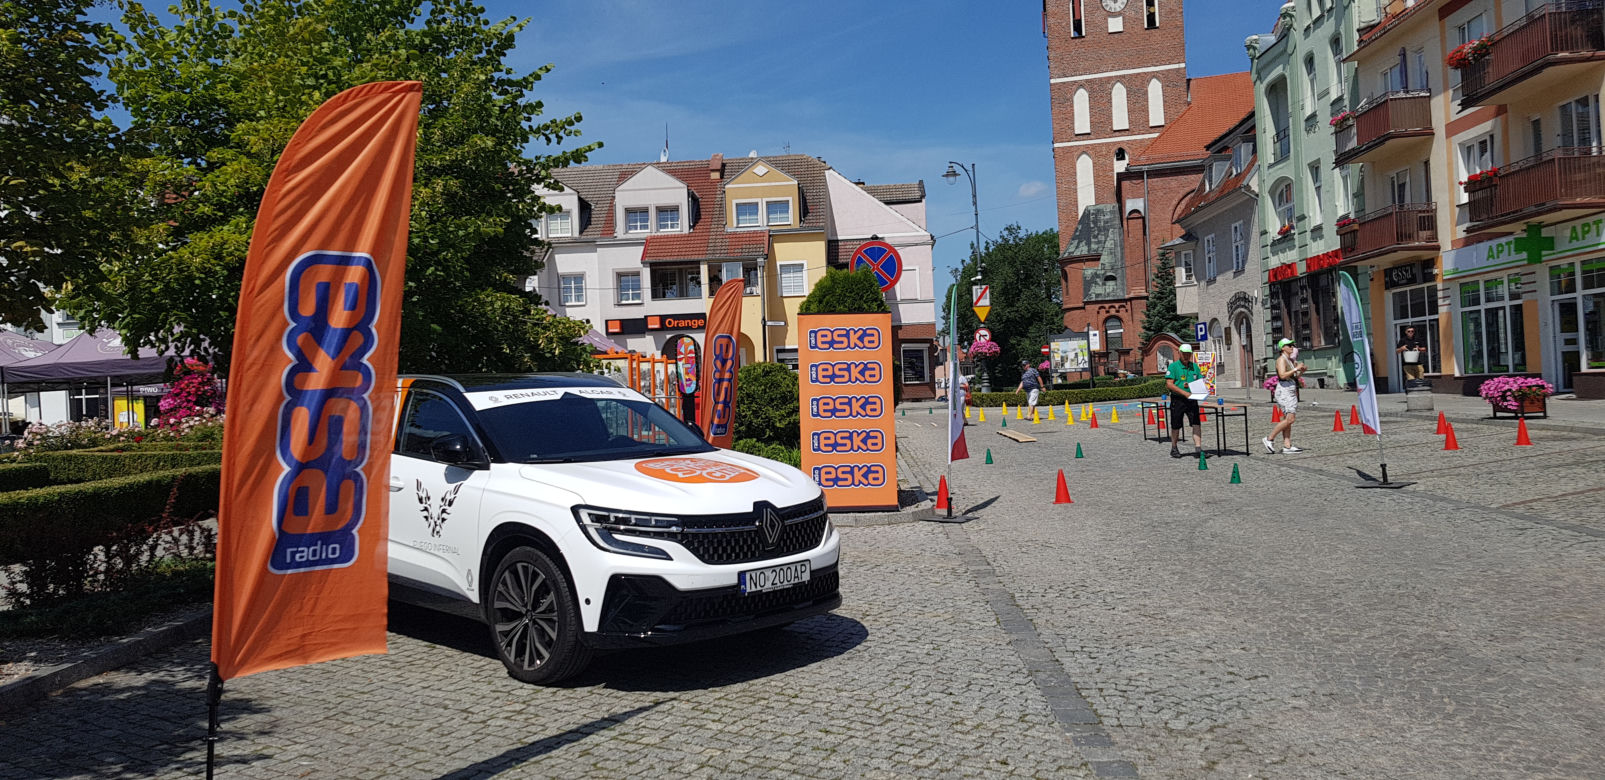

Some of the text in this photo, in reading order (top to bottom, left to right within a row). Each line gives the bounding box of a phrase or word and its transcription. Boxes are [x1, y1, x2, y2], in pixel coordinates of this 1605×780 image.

[665, 317, 705, 329] Orange
[1197, 324, 1206, 340] P
[816, 329, 880, 349] eska
[713, 337, 733, 425] eska
[817, 363, 881, 383] eska
[281, 263, 370, 535] eska
[504, 390, 559, 400] RENAULT
[818, 397, 882, 417] eska
[819, 431, 883, 452] eska
[820, 465, 884, 486] eska
[286, 541, 340, 563] radio
[749, 563, 807, 590] NO 200AP
